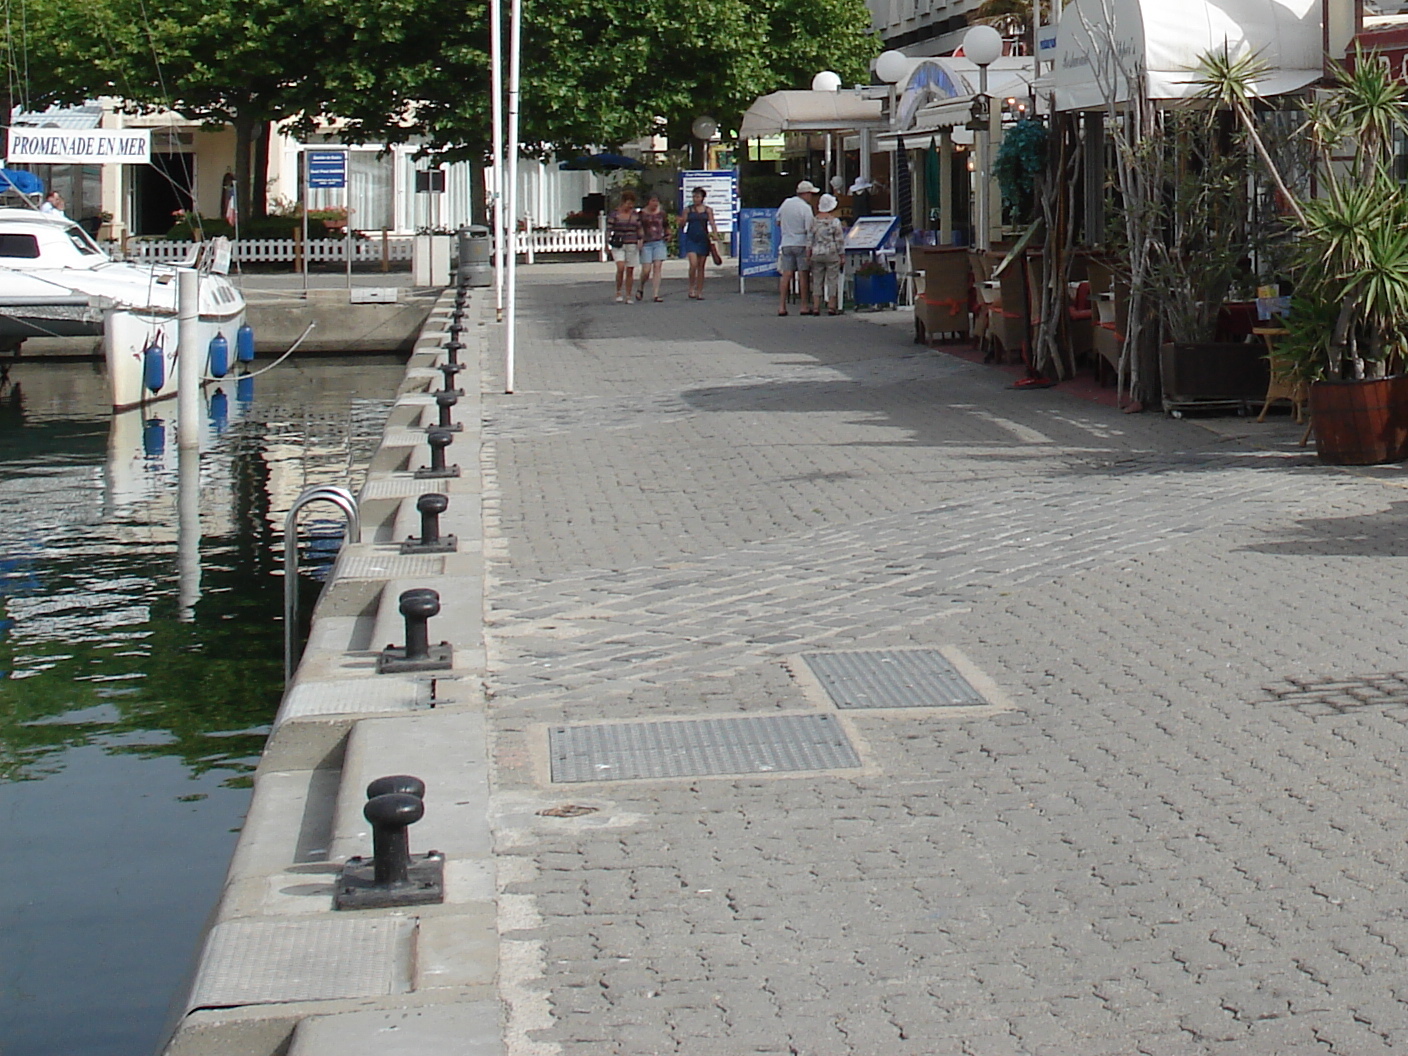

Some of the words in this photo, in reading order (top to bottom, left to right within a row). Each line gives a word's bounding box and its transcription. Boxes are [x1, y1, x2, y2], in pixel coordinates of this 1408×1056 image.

[12, 136, 95, 155] PROMENADE
[96, 137, 116, 155] EN
[116, 137, 146, 155] MER
